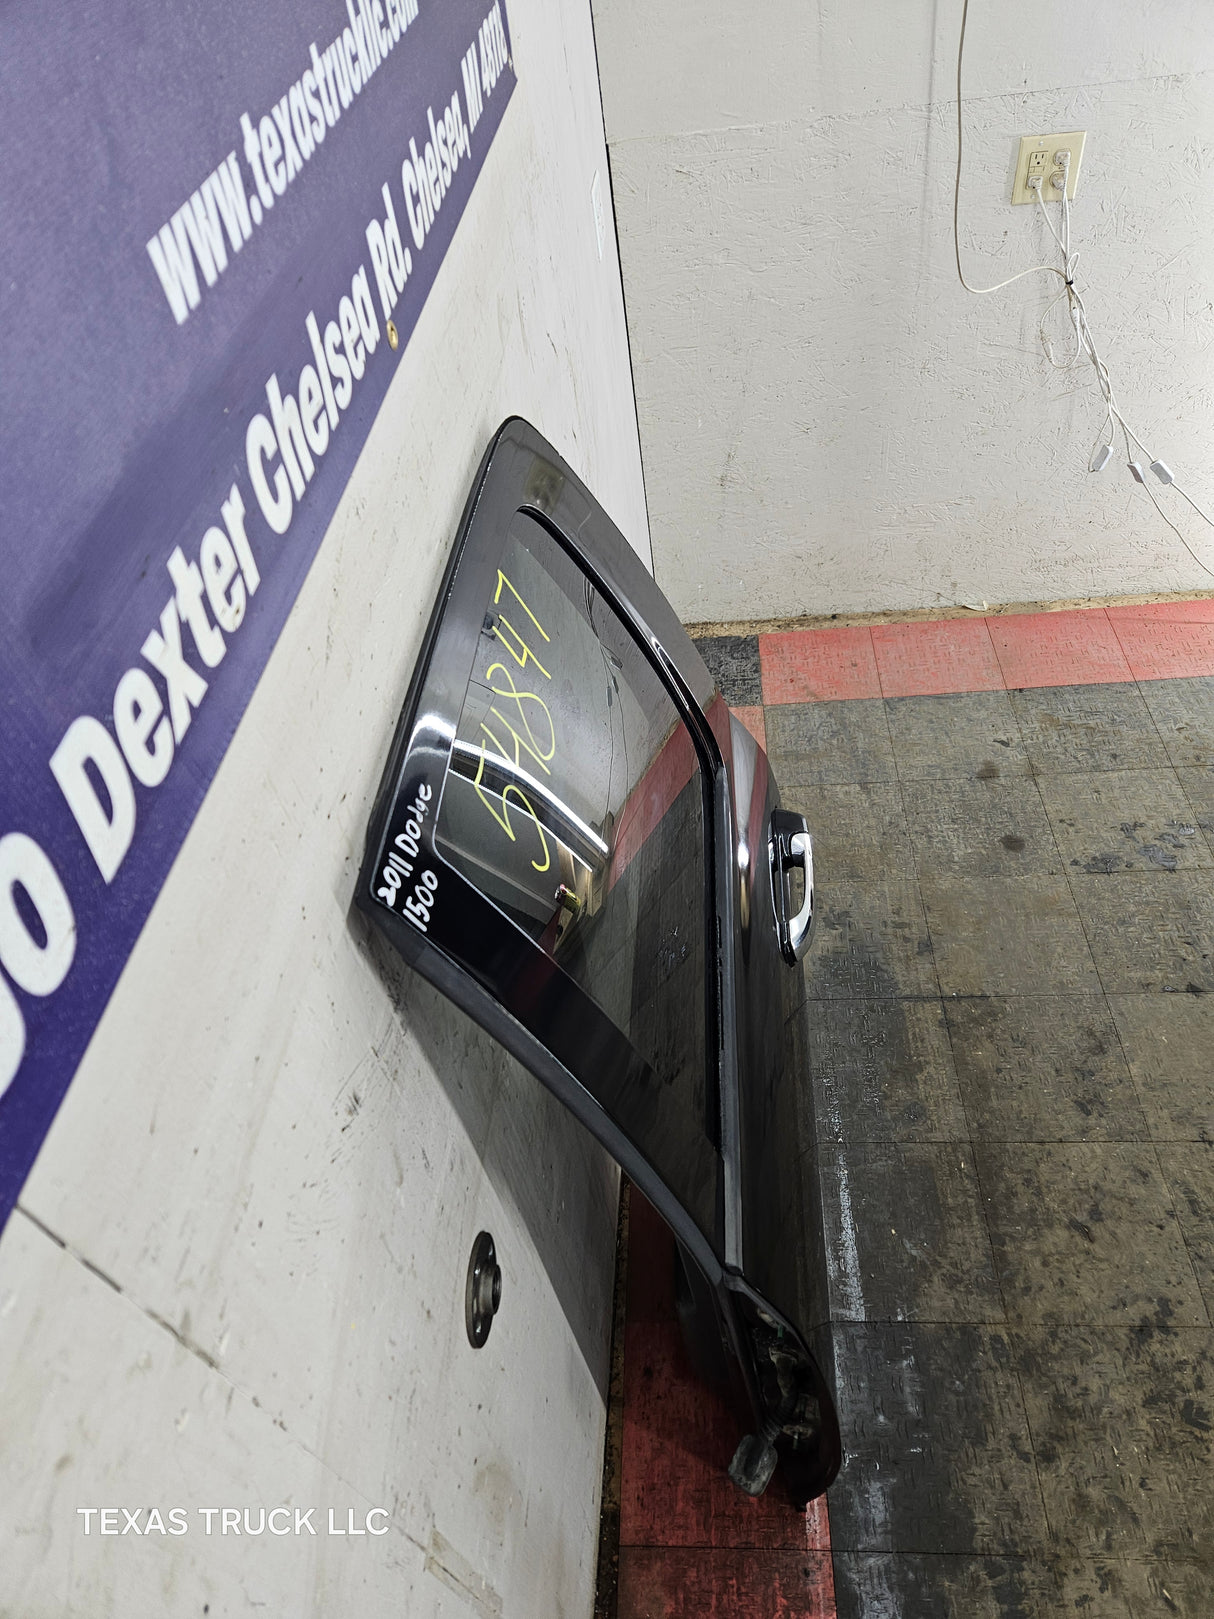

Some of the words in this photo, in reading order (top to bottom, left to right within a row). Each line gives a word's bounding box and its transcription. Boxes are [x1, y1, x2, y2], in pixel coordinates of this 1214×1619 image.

[50, 483, 261, 884] Dexter
[246, 265, 380, 535] Chelsea
[366, 182, 412, 319] Rd.
[402, 90, 471, 250] Chelsea,
[461, 41, 483, 134] MI
[474, 569, 555, 872] 54847
[394, 783, 432, 858] Dodge
[377, 851, 414, 907] 2011
[402, 869, 438, 932] 1500
